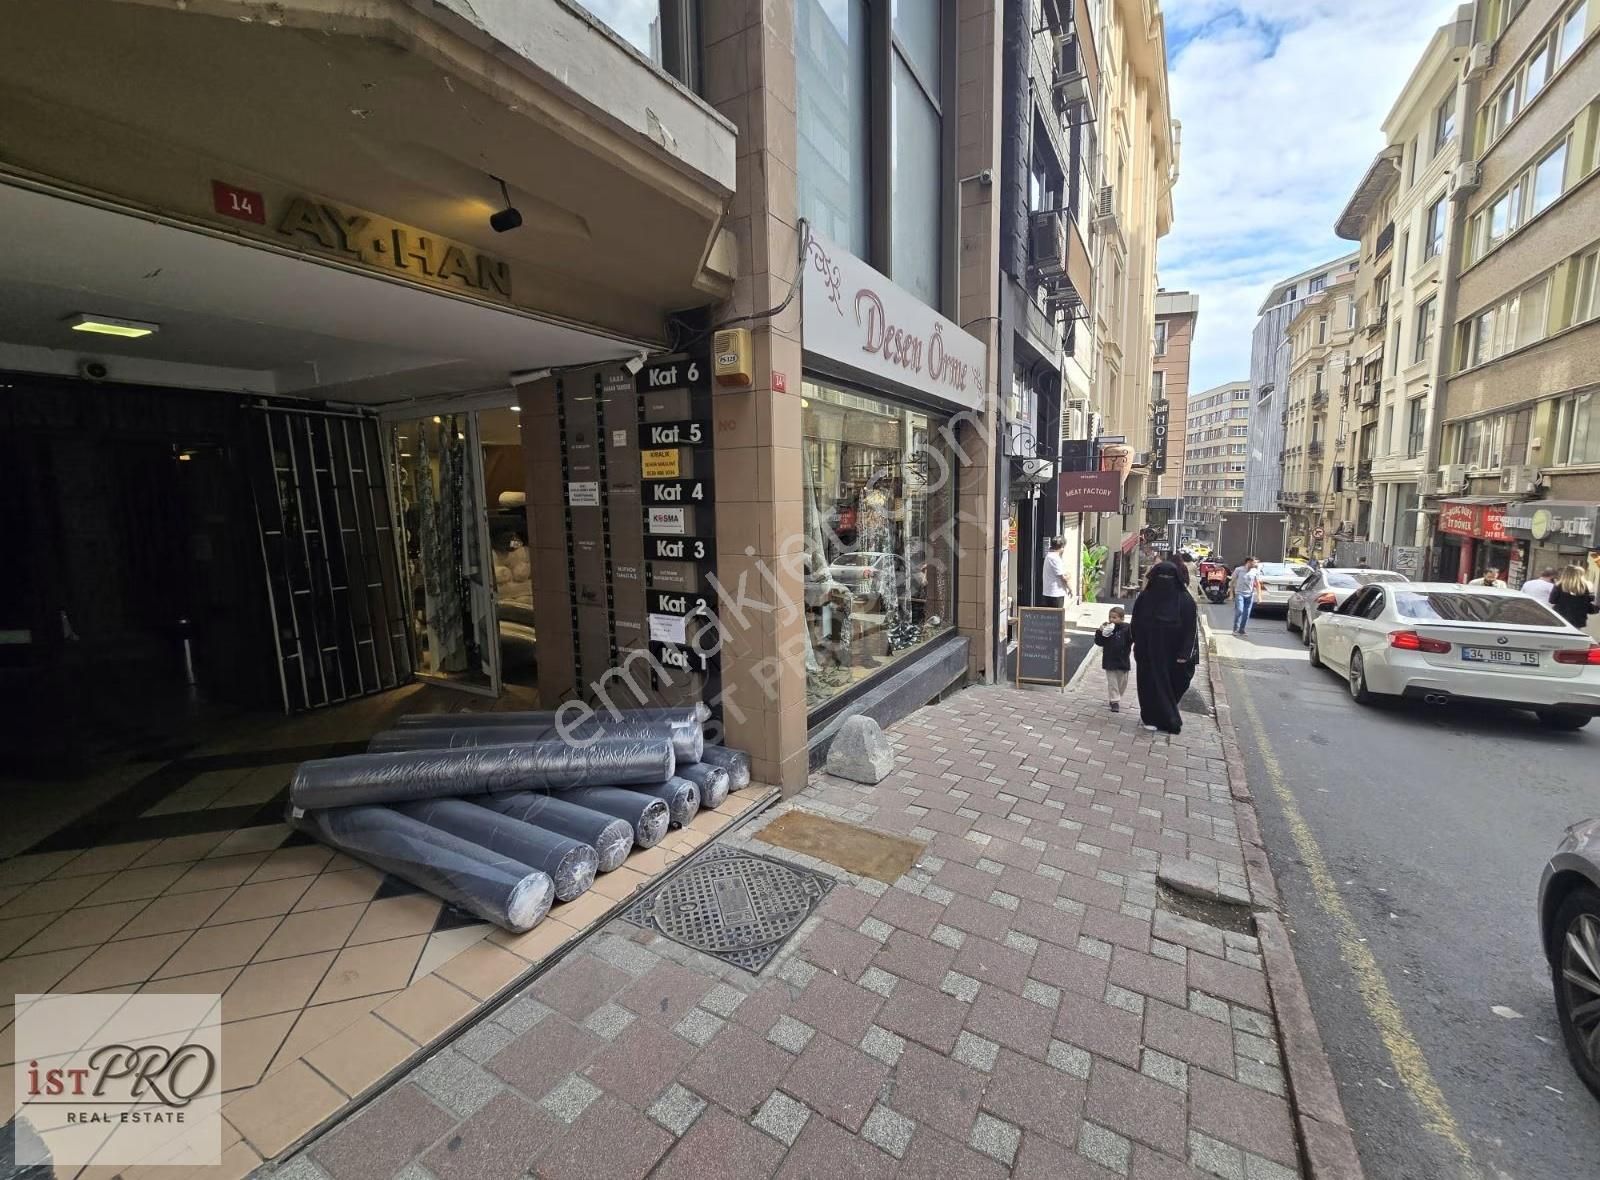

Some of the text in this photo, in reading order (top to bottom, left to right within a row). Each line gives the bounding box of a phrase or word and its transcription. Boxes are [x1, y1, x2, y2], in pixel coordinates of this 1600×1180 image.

[229, 192, 252, 215] 14
[855, 288, 968, 391] Desen Örme
[649, 363, 699, 386] Kat 6
[651, 424, 702, 443] Kat 5
[1155, 415, 1166, 469] HOTEL
[653, 483, 682, 501] Kat
[691, 482, 704, 500] 4
[1065, 488, 1112, 497] MEAT FACTORY
[656, 540, 705, 559] Kat 3
[659, 594, 707, 615] Kat 2
[661, 647, 707, 670] Kat 1
[1470, 649, 1536, 663] 34 HBD 15
